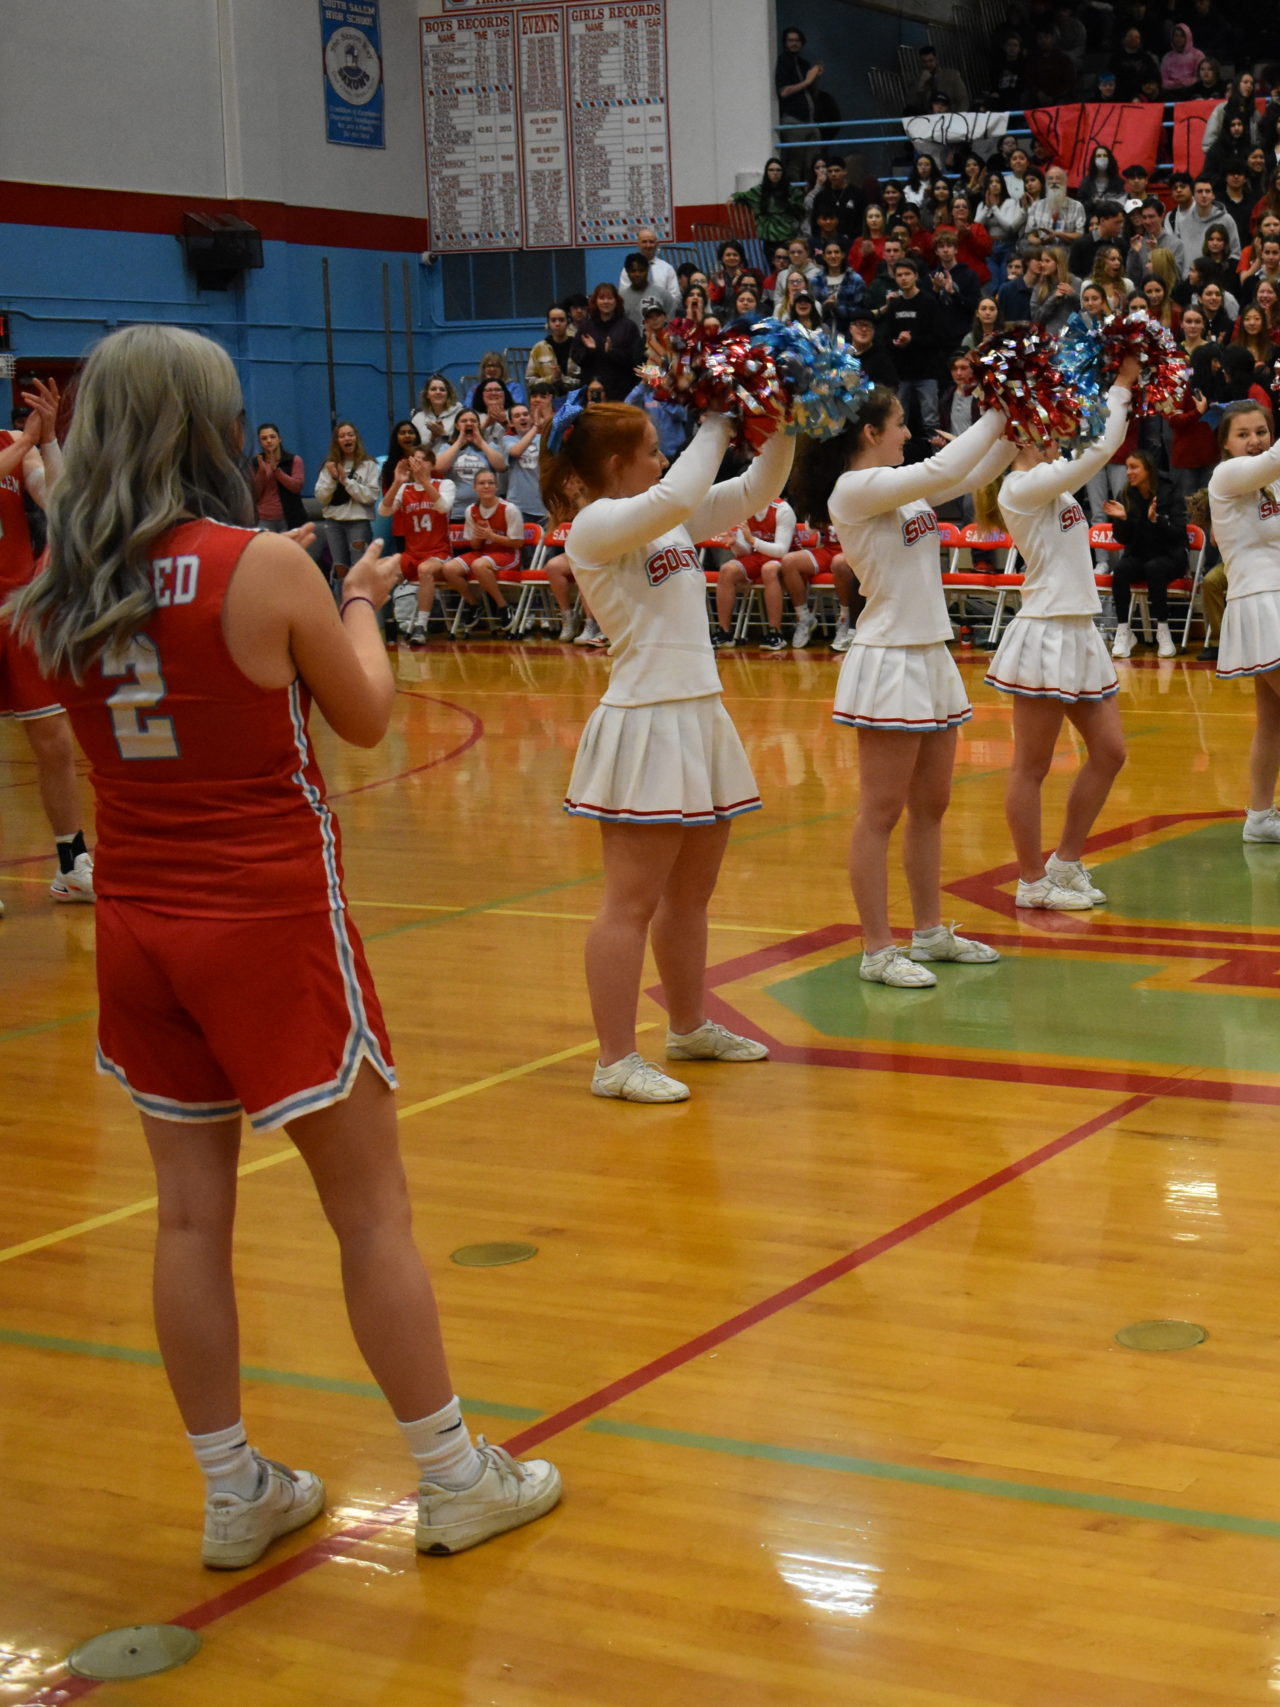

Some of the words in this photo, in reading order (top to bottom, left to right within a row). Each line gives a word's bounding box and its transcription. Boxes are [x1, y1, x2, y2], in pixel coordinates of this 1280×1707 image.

[572, 8, 605, 22] GIRLS
[609, 4, 662, 19] RECORDS
[425, 21, 453, 33] BOYS
[457, 16, 510, 30] RECORDS
[522, 13, 560, 35] EVENTS
[585, 22, 604, 33] NAME
[624, 20, 639, 29] TIME
[645, 18, 661, 28] YEAR
[438, 33, 457, 43] NAME
[474, 31, 488, 40] TIME
[494, 30, 510, 39] YEAR
[412, 513, 432, 533] 14
[101, 631, 181, 762] 2
